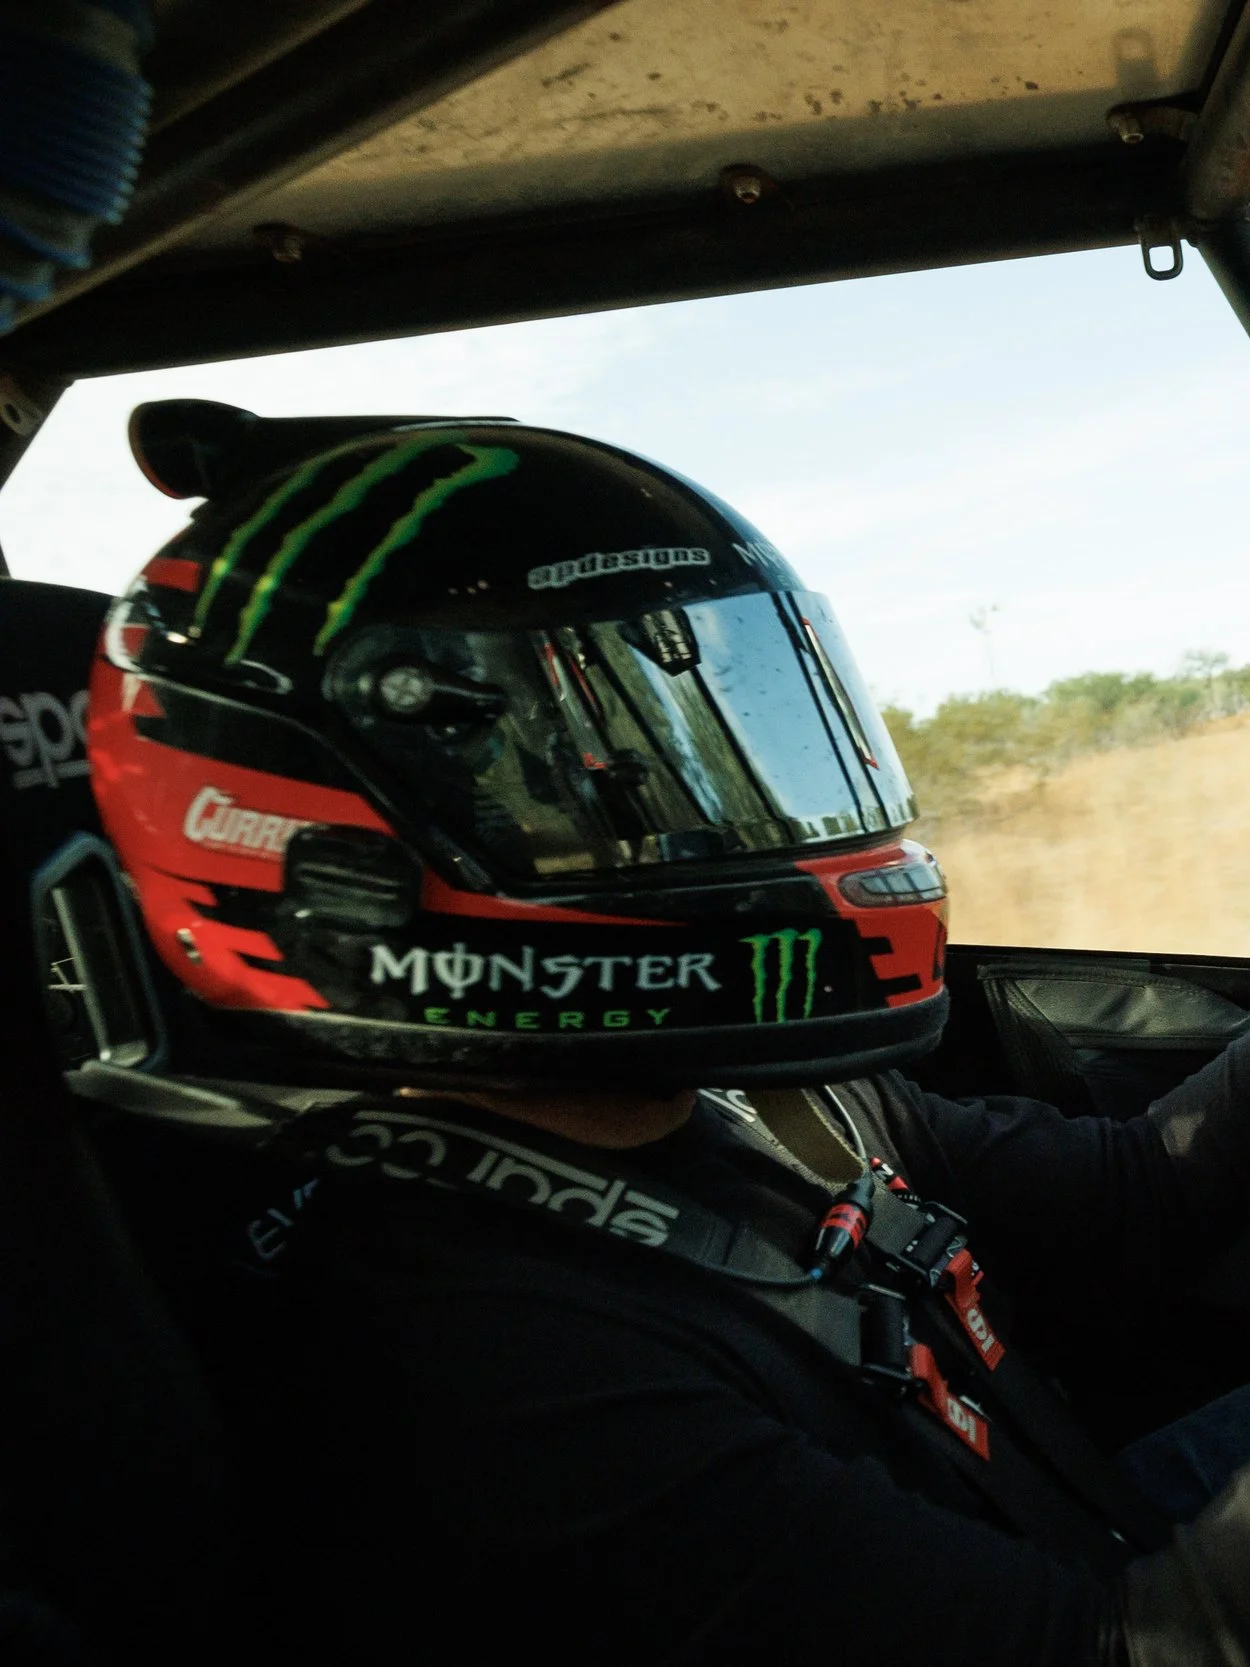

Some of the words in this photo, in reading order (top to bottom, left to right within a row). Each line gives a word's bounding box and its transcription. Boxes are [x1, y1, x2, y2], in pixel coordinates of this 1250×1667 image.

[527, 547, 711, 590] apdesigns
[371, 943, 722, 999] MONSTER
[424, 1007, 672, 1030] ENERGY
